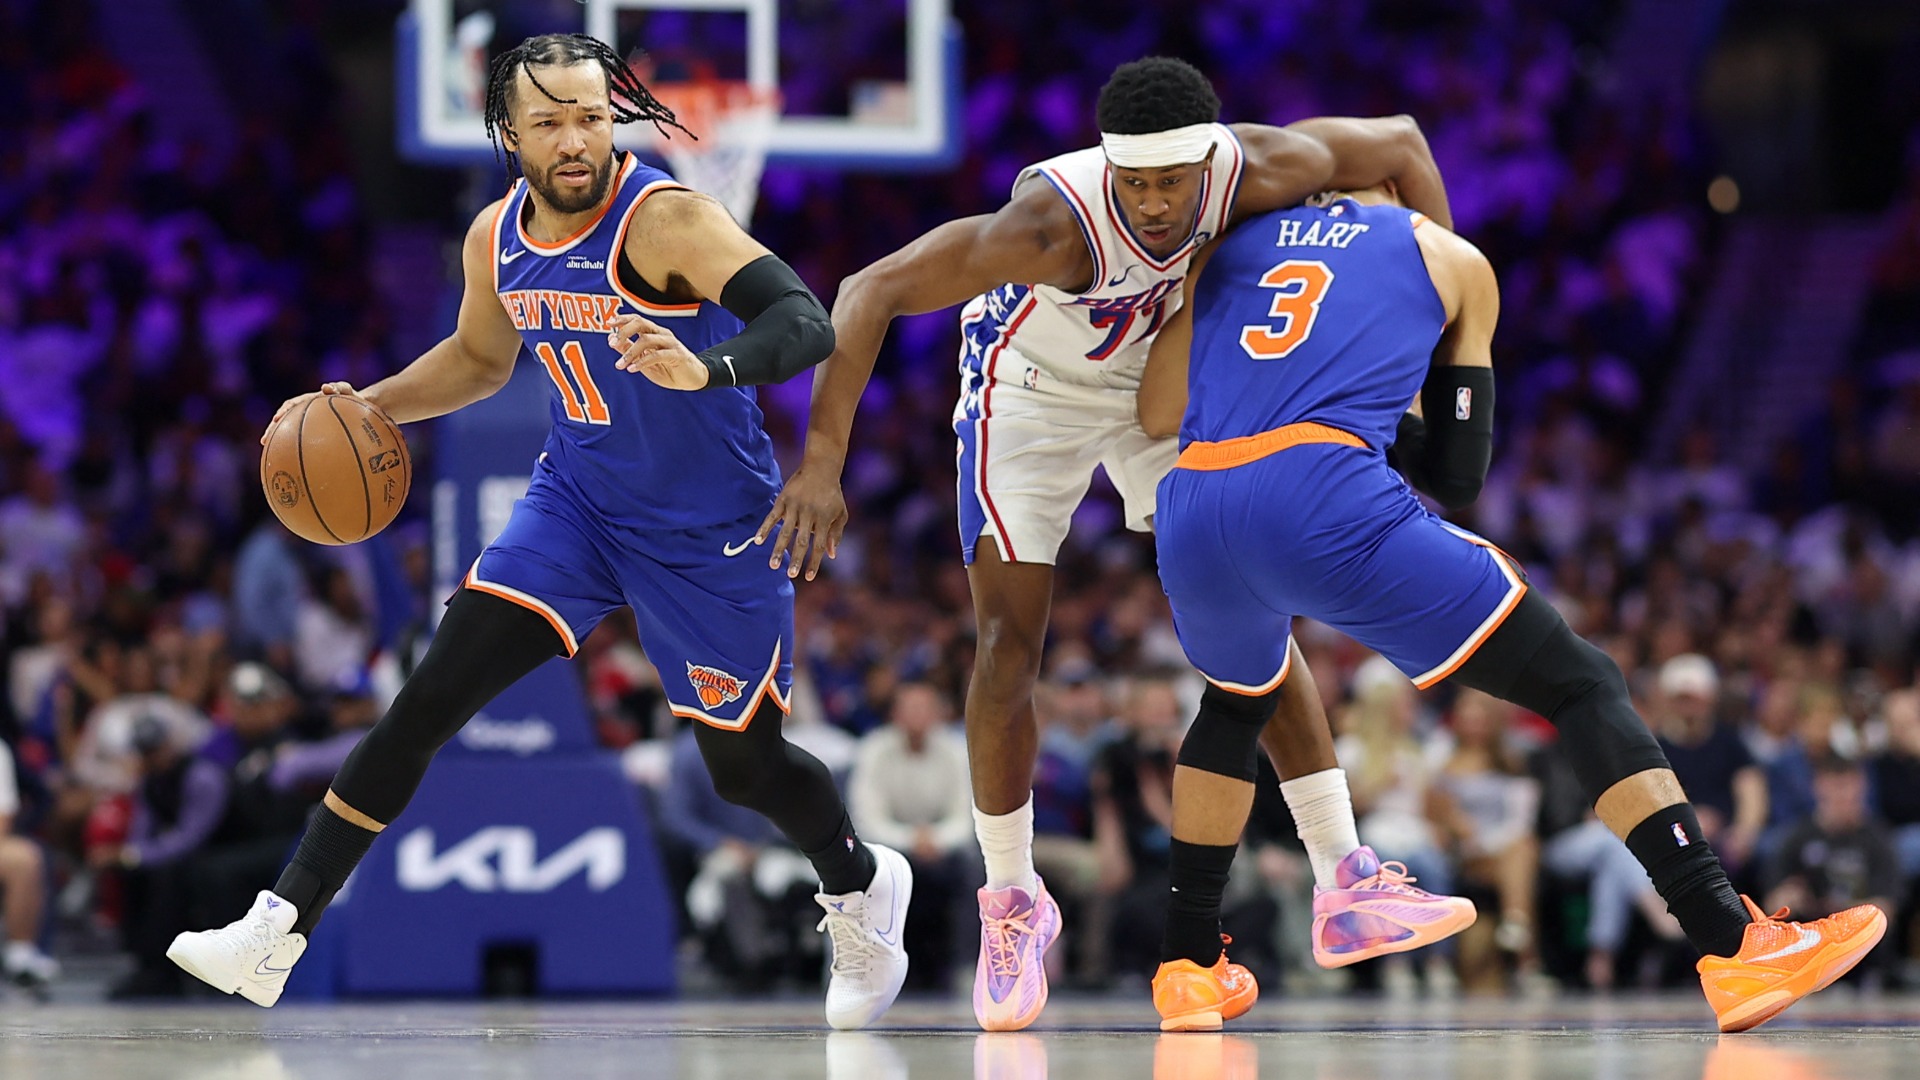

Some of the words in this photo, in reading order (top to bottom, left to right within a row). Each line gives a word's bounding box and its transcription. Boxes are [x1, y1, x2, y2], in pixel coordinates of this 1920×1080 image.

[1276, 219, 1370, 249] HART
[542, 289, 624, 334] YORK
[1239, 259, 1335, 360] 3
[535, 340, 611, 426] 11
[688, 667, 740, 697] KNICKS
